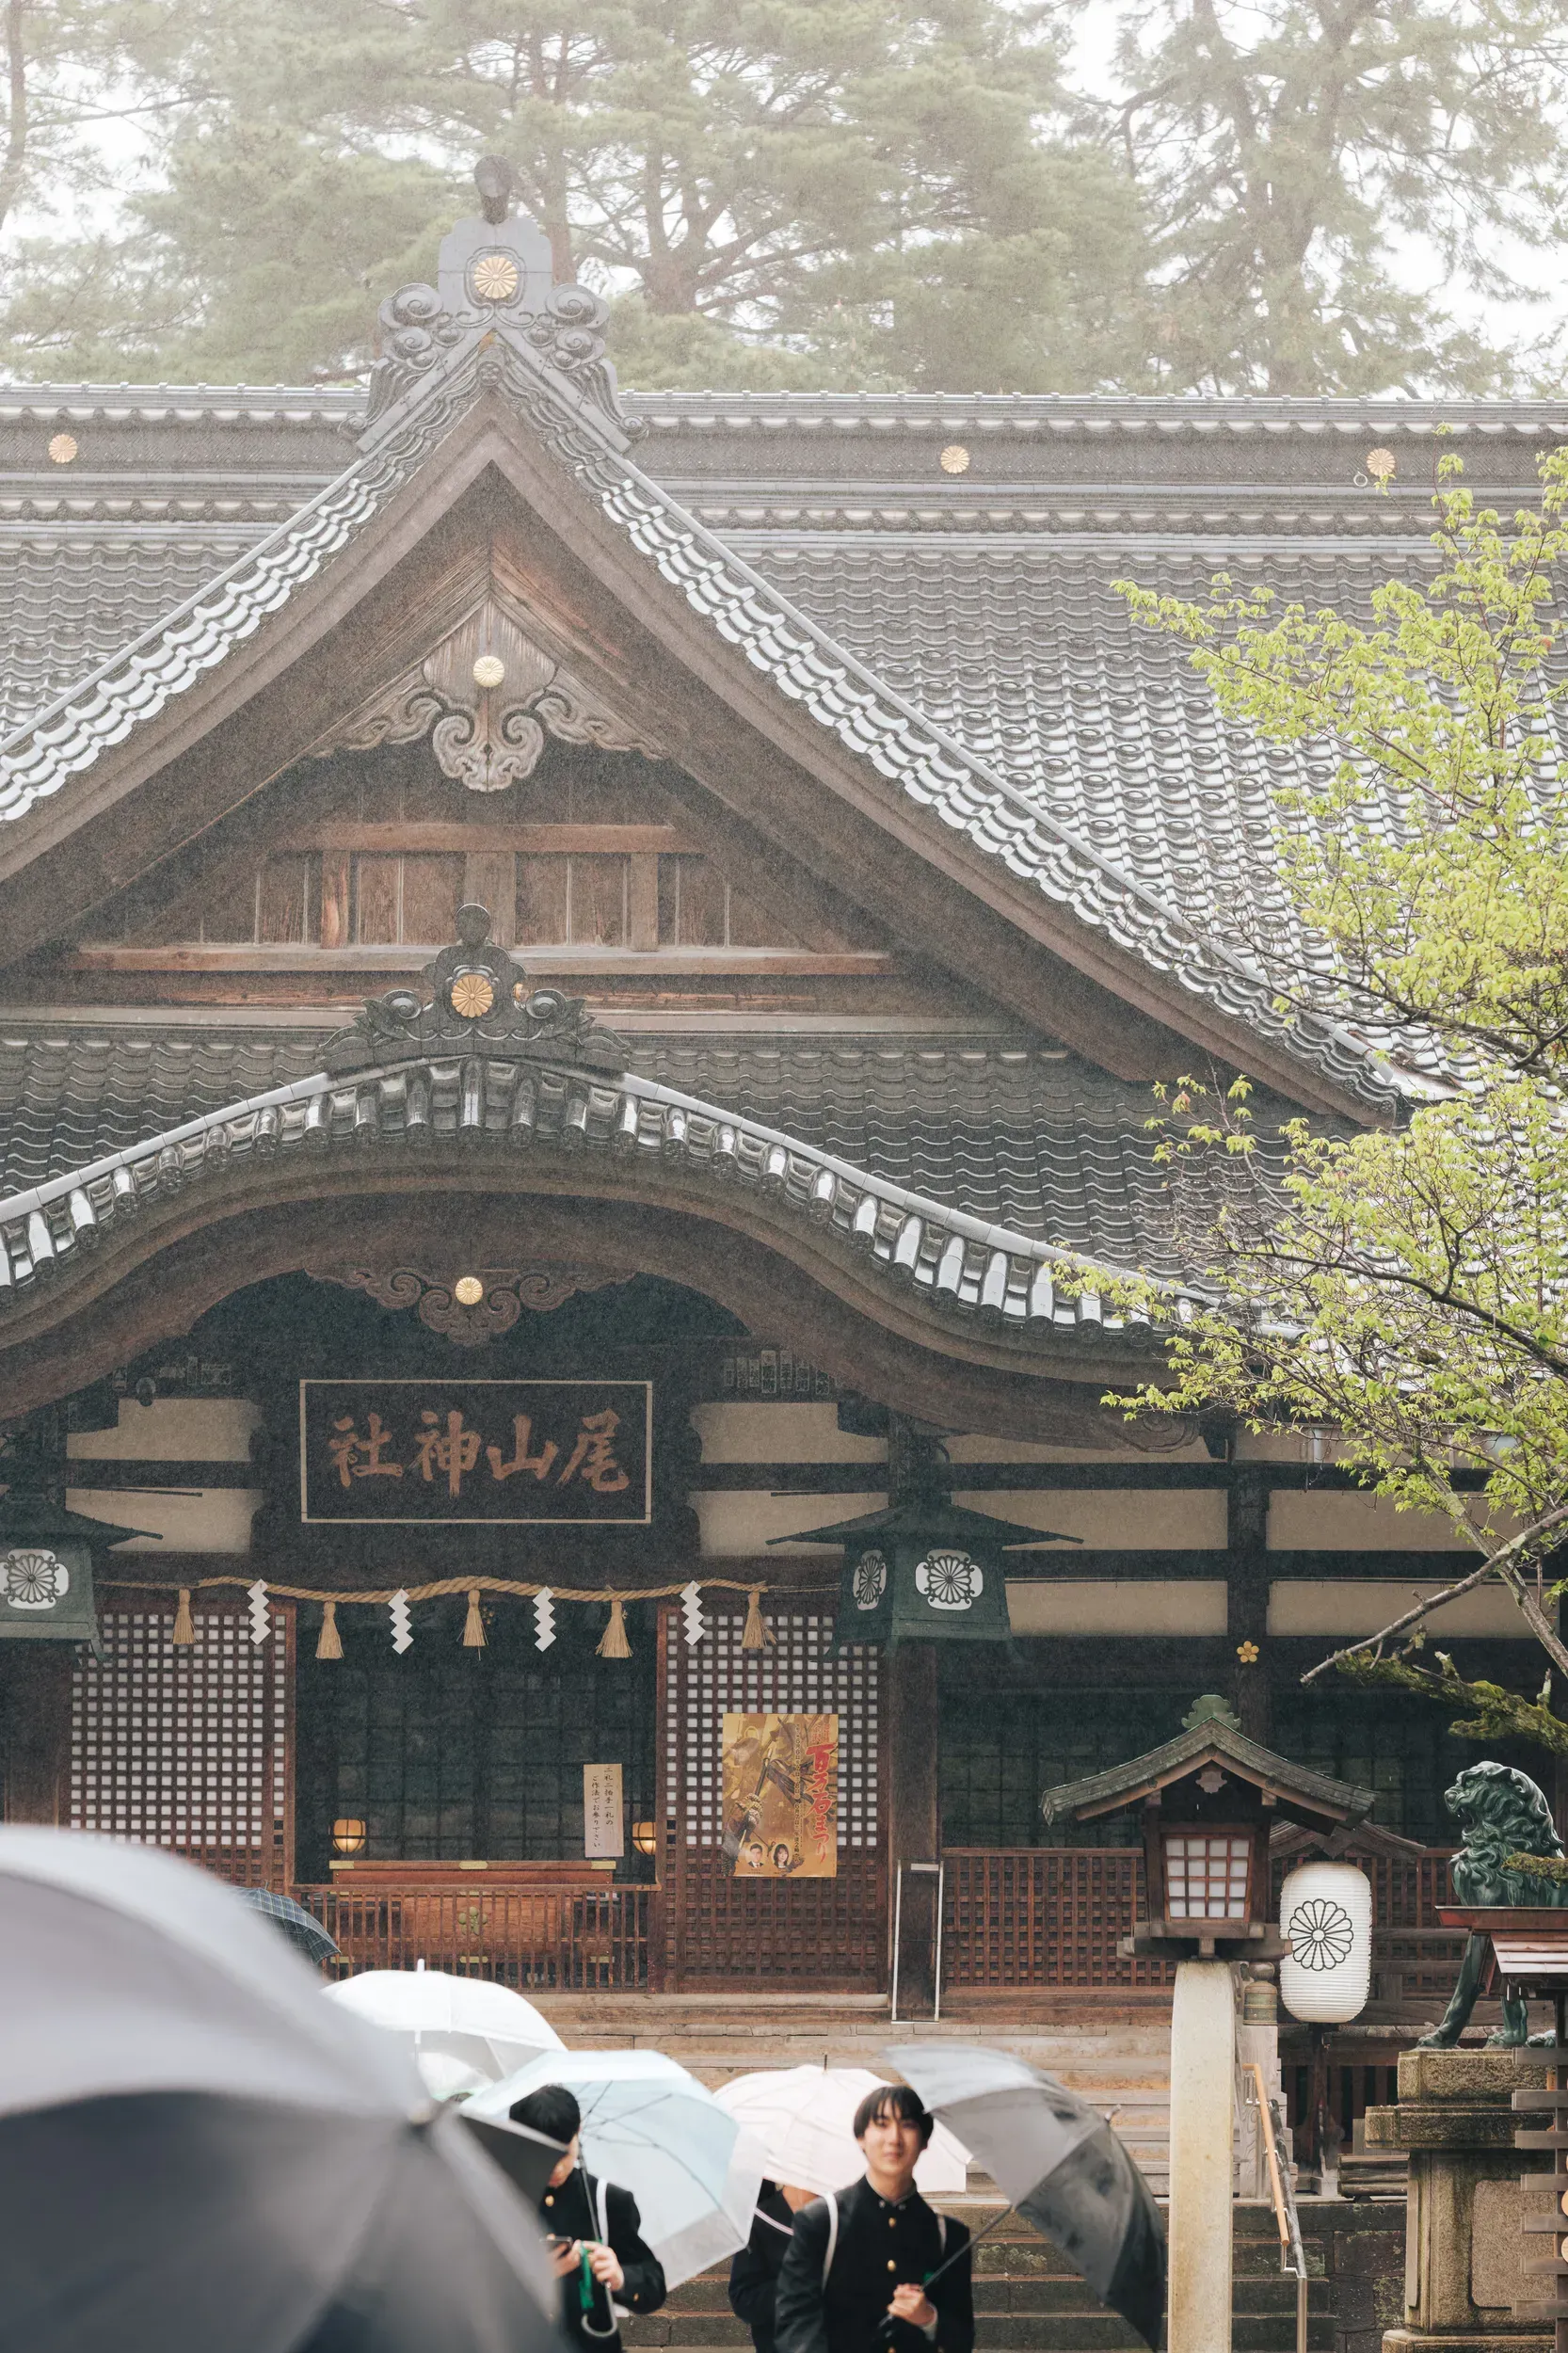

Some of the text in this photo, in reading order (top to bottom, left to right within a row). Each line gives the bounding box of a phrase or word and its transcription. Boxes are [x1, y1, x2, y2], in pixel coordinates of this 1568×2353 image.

[328, 1408, 631, 1500] 尾山神社
[603, 1767, 615, 1826] 二礼二拍手一礼の
[803, 1741, 838, 1864] 百万石まつり
